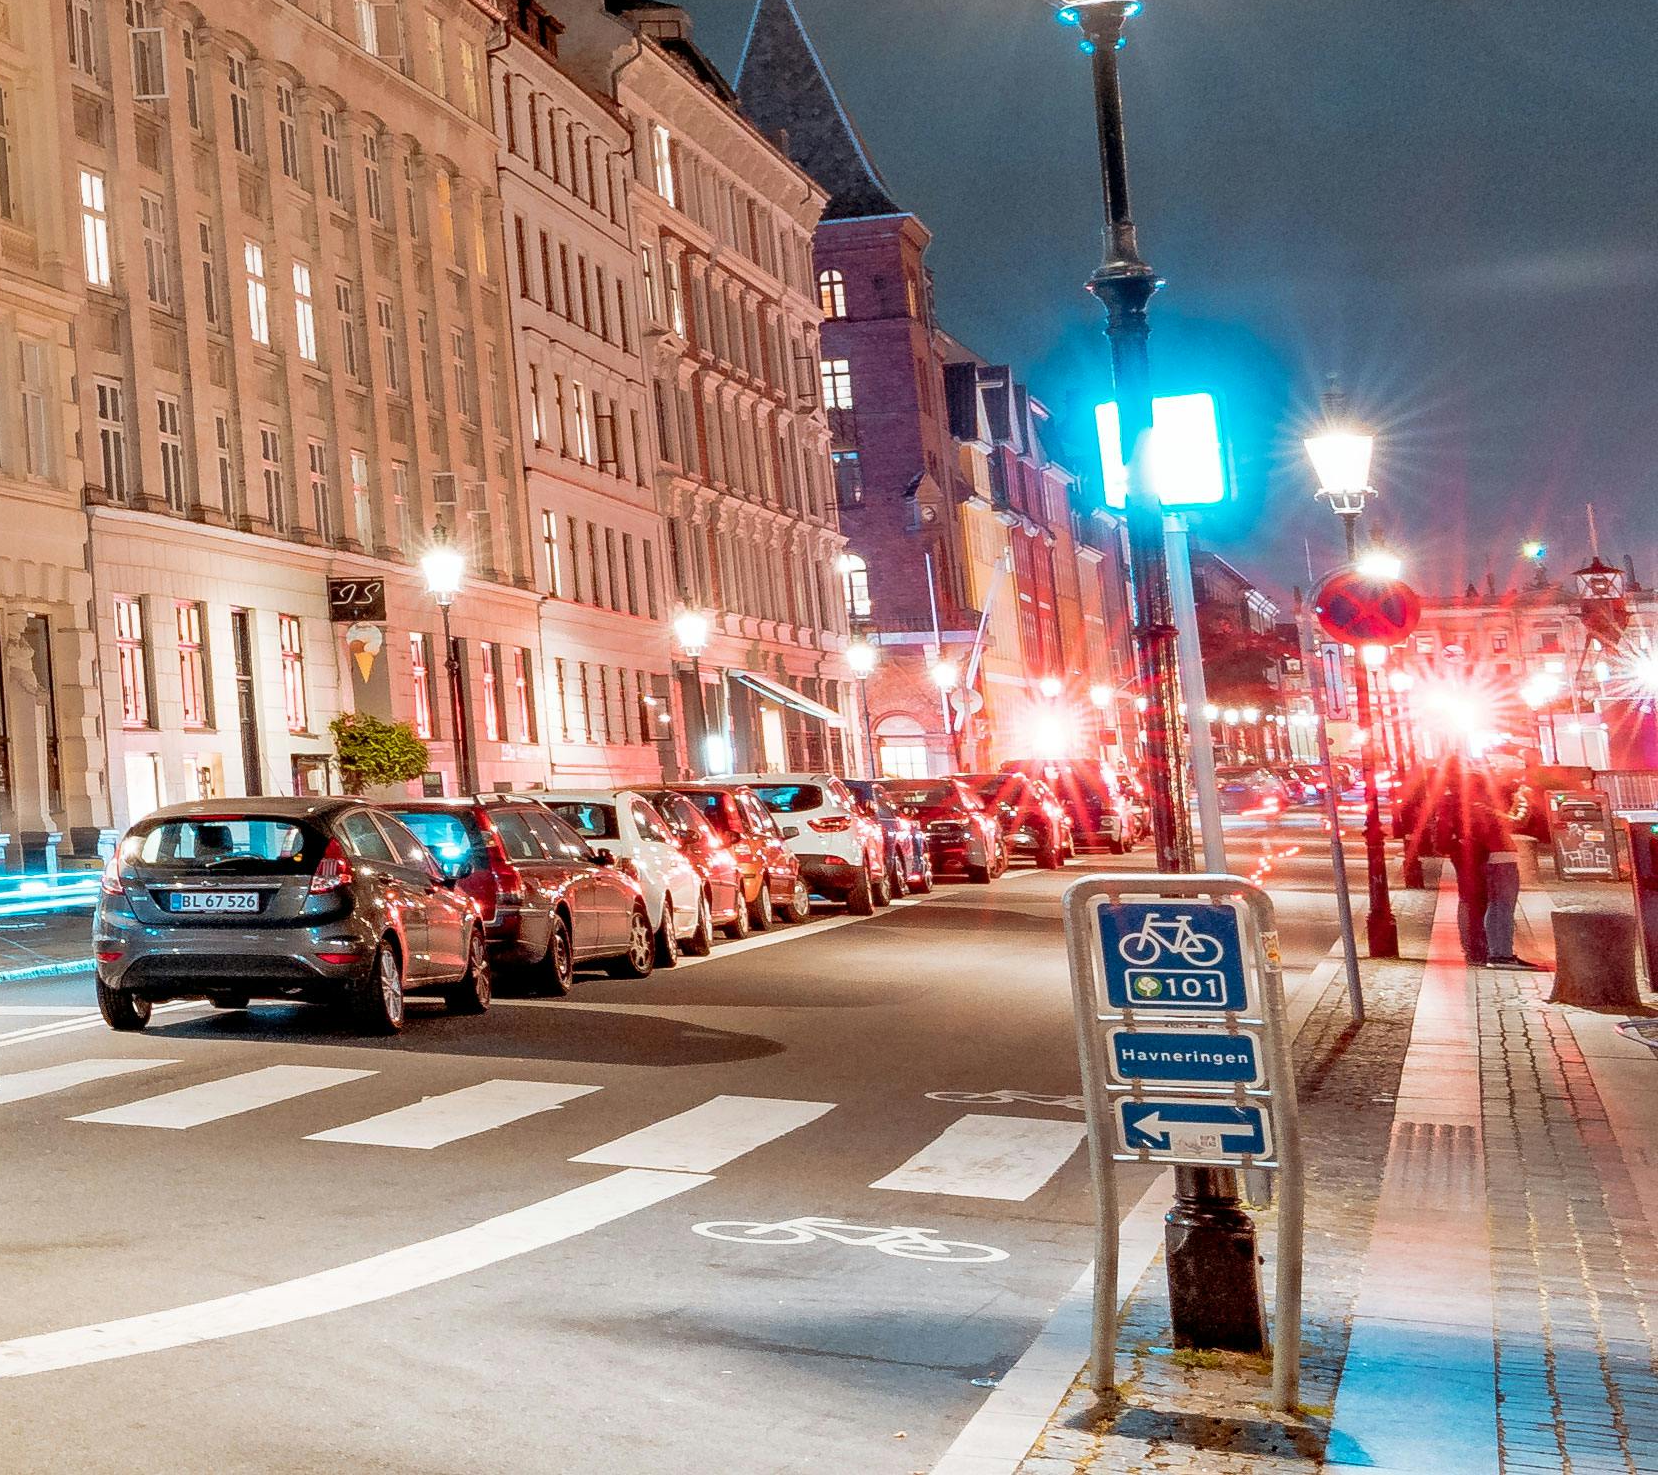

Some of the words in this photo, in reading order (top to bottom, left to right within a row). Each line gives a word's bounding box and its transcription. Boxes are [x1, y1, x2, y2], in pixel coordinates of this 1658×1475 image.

[182, 895, 201, 908] BL
[206, 895, 223, 908] 67
[227, 895, 256, 908] 526
[1165, 978, 1217, 997] 101
[1121, 1049, 1248, 1065] Havneringen
